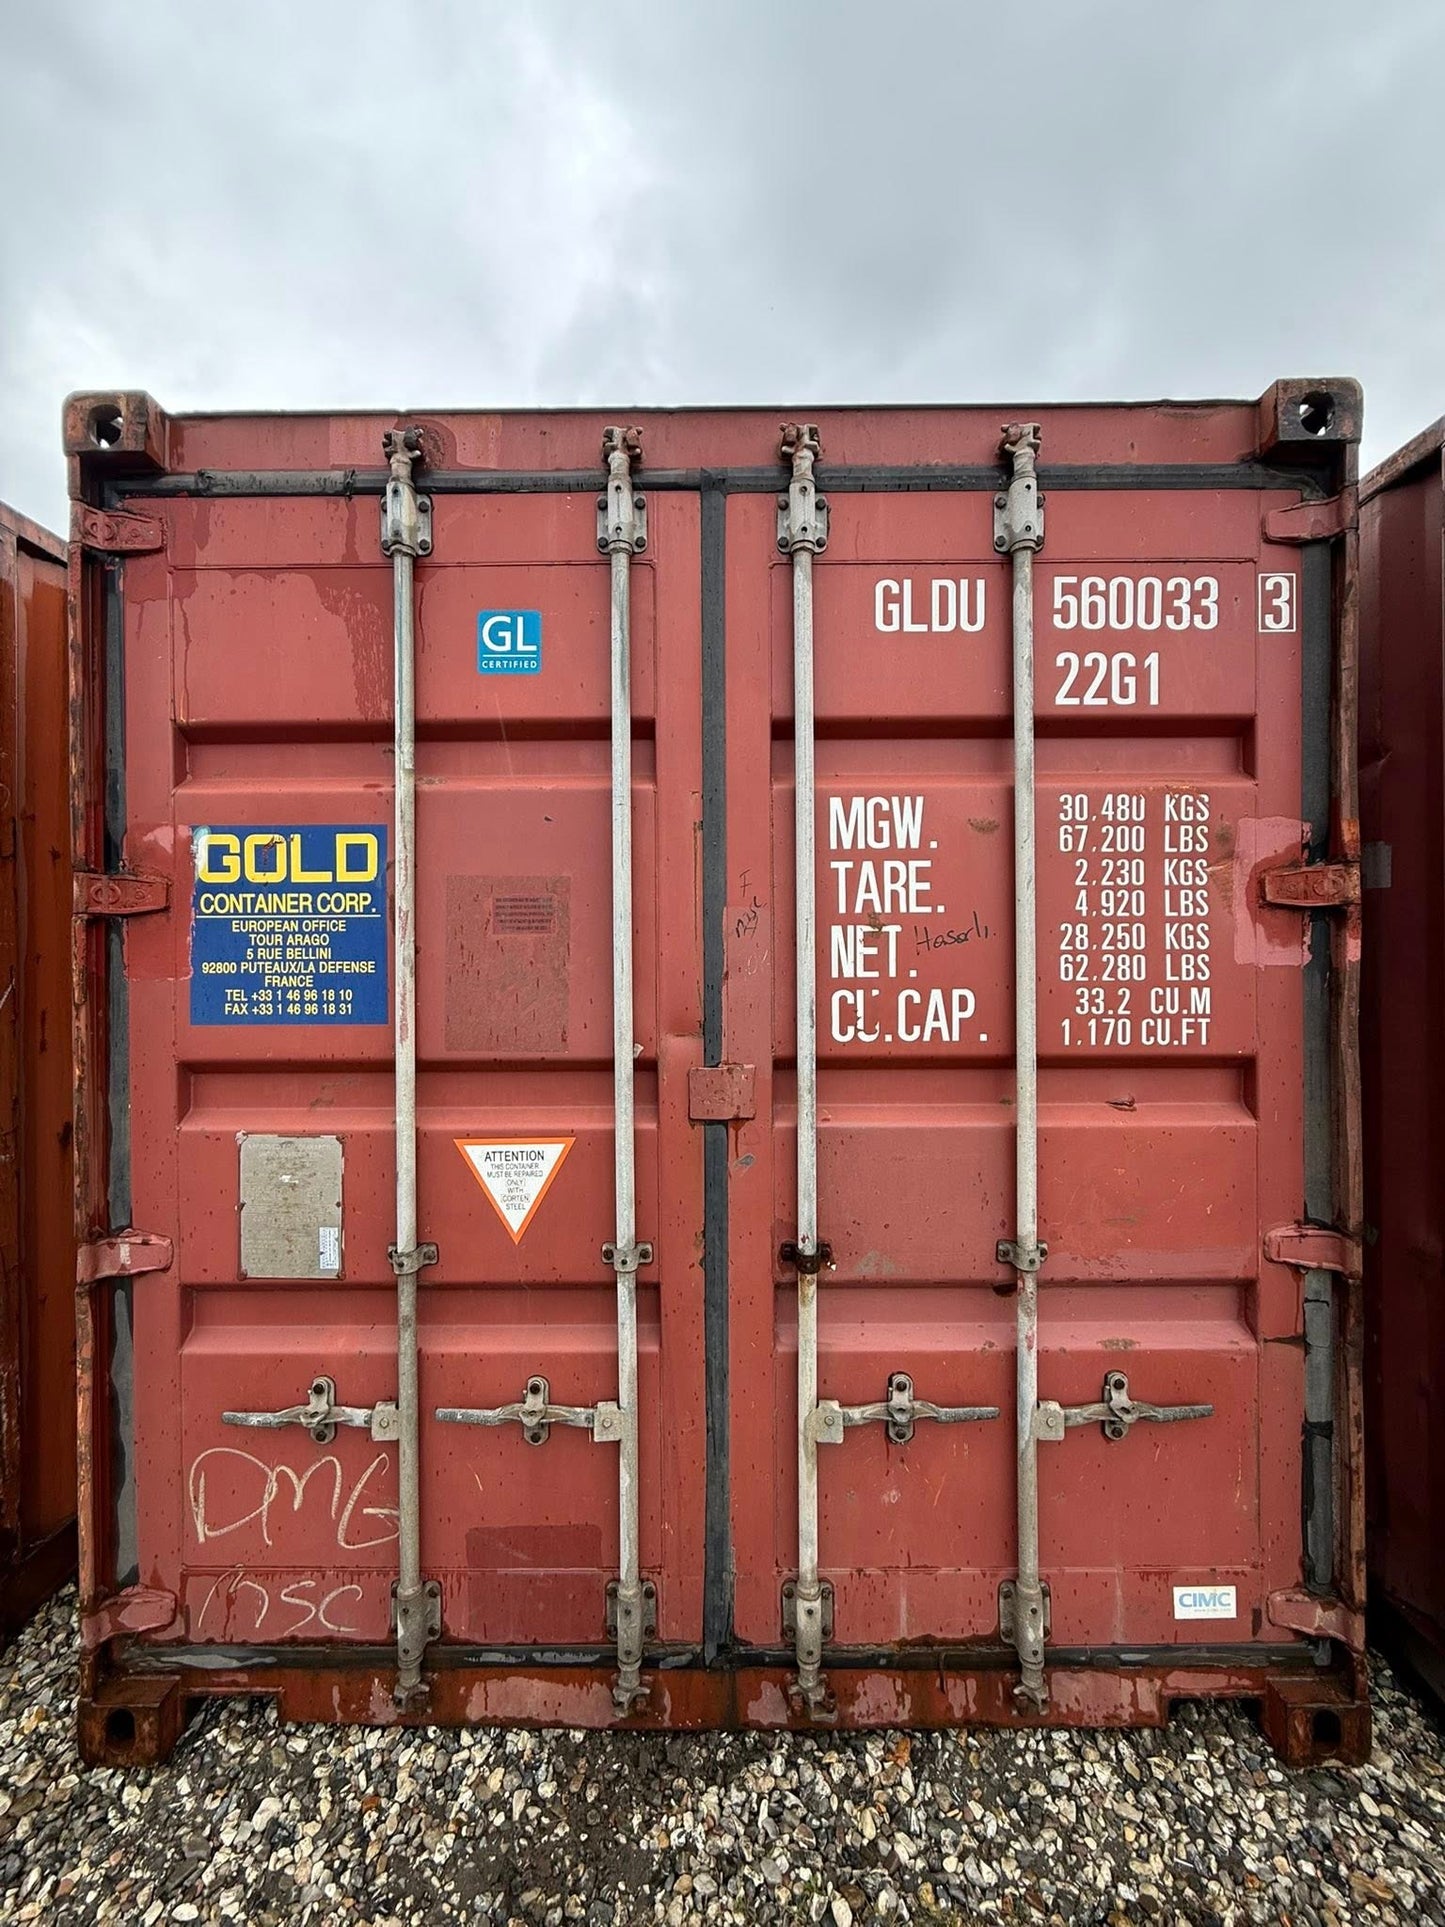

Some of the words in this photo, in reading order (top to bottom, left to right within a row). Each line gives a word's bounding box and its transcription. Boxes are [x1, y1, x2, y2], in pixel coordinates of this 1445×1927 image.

[874, 578, 986, 633] GLDU
[1053, 576, 1219, 630] 560033
[1264, 576, 1291, 630] 3
[482, 615, 537, 652] GL
[482, 660, 537, 669] CERTIFIED
[1055, 651, 1160, 706] 22G1
[1059, 794, 1146, 822] 30,480
[1164, 794, 1210, 822] KGS
[829, 796, 938, 850] MGW.
[1059, 825, 1146, 852] 67,200
[1164, 825, 1209, 852] LBS
[198, 833, 378, 883] GOLD
[1075, 858, 1146, 886] 2,230
[1164, 858, 1209, 886] KGS
[830, 860, 945, 914] TARE.
[200, 893, 312, 914] CONTAINER
[317, 892, 377, 914] CORP.
[1075, 889, 1146, 917] 4,920
[1164, 889, 1210, 917] LBS
[232, 921, 299, 932] EUROPEAN
[302, 920, 347, 932] OFFICE
[1060, 923, 1146, 950] 28,250
[1165, 923, 1210, 950] KGS
[249, 934, 283, 946] TOUR
[286, 934, 330, 946] ARAGO
[831, 924, 917, 978] NET.
[202, 962, 237, 974] 92800
[241, 962, 316, 973] PUTEAUX/LA
[319, 961, 376, 973] DEFENSE
[246, 948, 254, 960] 5
[257, 948, 282, 960] RUE
[286, 948, 332, 959] BELLINI
[1060, 954, 1147, 981] 62,280
[1165, 954, 1211, 981] LBS
[265, 975, 314, 987] FRANCE
[225, 989, 248, 1001] TEL
[251, 989, 273, 1001] +33
[276, 989, 282, 1001] 1
[286, 989, 300, 1001] 46
[304, 989, 318, 1001] 96
[322, 989, 335, 1001] 18
[339, 989, 353, 1001] 10
[1075, 987, 1131, 1015] 33.2
[1150, 987, 1211, 1015] CU.M
[224, 1003, 249, 1015] FAX
[252, 1003, 273, 1015] +33
[277, 1003, 282, 1015] 1
[287, 1003, 301, 1015] 46
[304, 1003, 318, 1015] 96
[322, 1003, 335, 1015] 18
[339, 1003, 352, 1015] 31
[1061, 1018, 1131, 1046] 1,170
[1141, 1018, 1211, 1046] CU.FT
[484, 1150, 545, 1162] ATTENTION
[505, 1162, 540, 1170] CONTAINER
[504, 1170, 512, 1178] BE
[514, 1170, 543, 1178] REPAIRED
[506, 1203, 526, 1211] STEEL
[1179, 1592, 1231, 1608] CIMC
